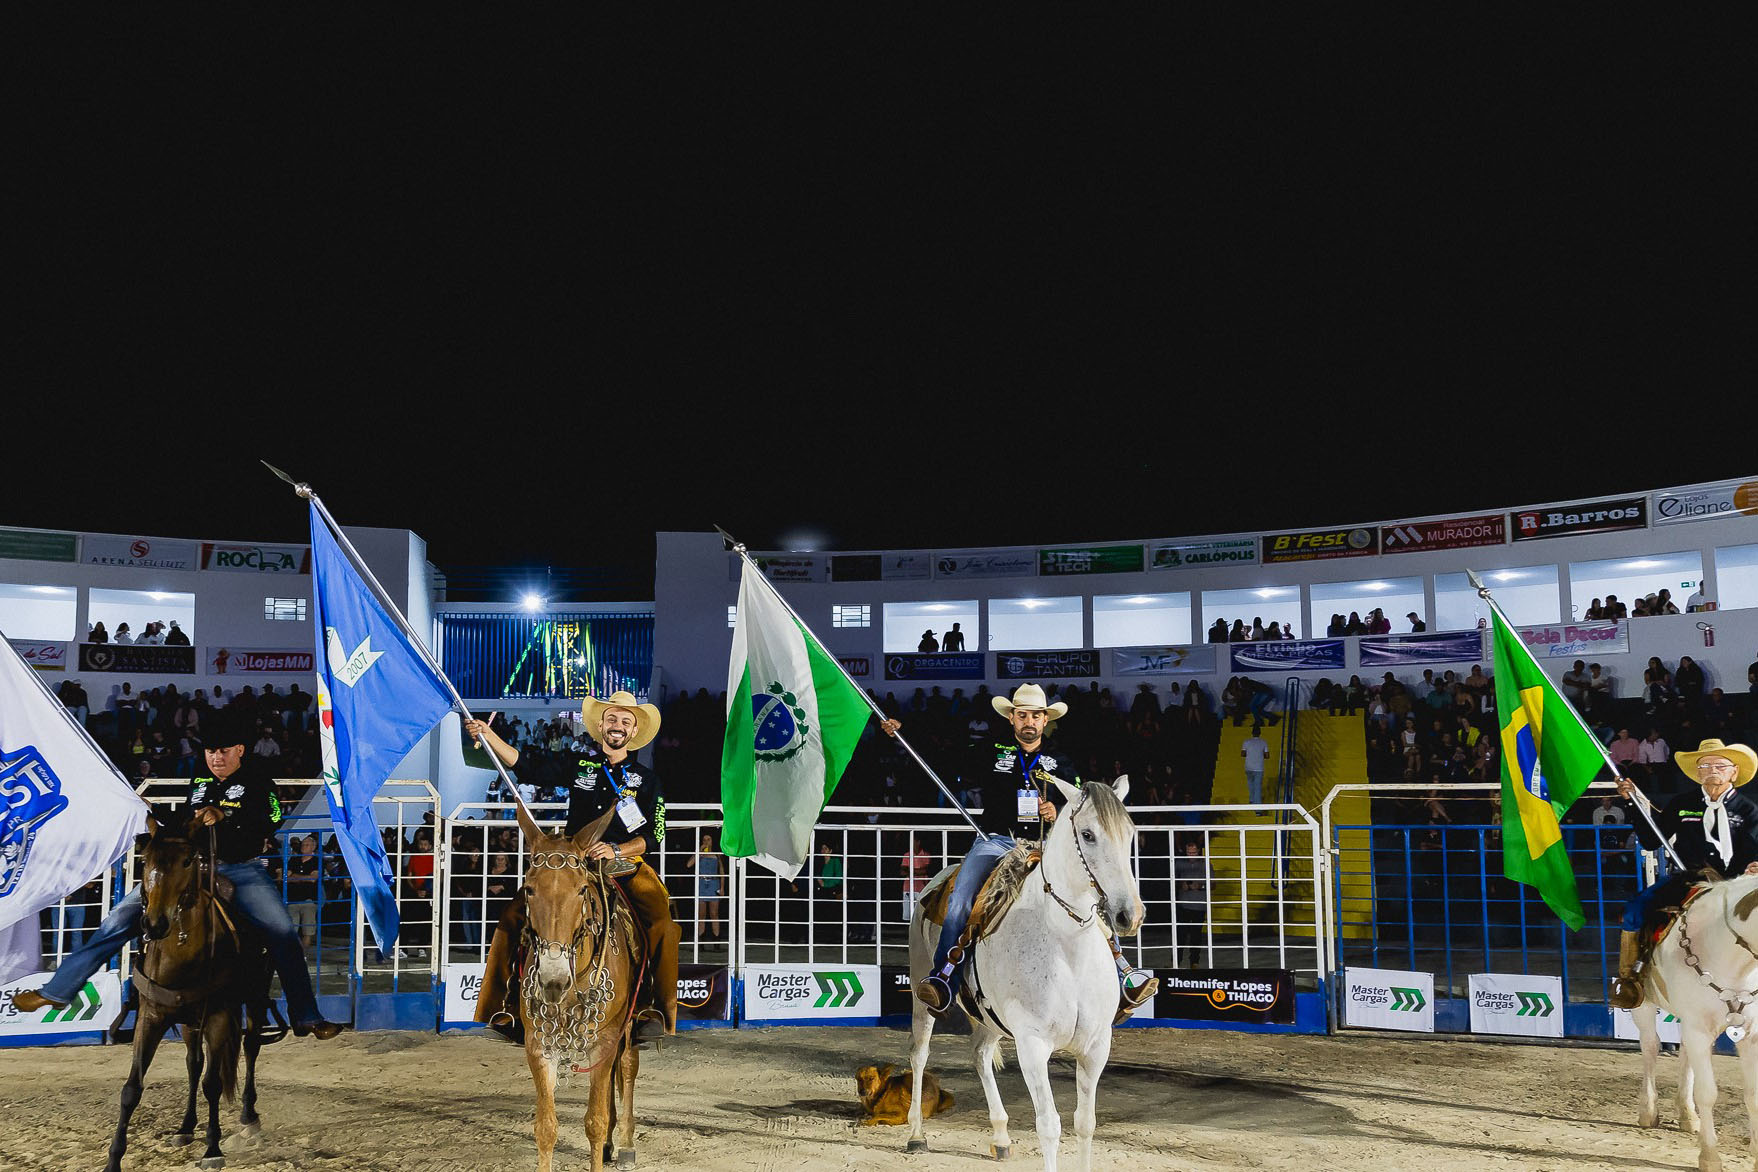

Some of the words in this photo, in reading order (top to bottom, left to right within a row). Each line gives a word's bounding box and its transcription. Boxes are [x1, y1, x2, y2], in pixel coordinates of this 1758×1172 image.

[1427, 525, 1492, 542] MURADOR
[1495, 524, 1503, 536] II
[91, 556, 135, 567] ARENA
[1185, 549, 1255, 563] CARLÓPOLIS
[1056, 562, 1091, 573] TECH
[1549, 643, 1587, 656] Festas
[250, 655, 311, 670] LojasMM
[1036, 652, 1092, 664] GRUPO
[346, 651, 368, 681] 2007
[1033, 664, 1095, 676] TANTINI
[677, 980, 707, 989] opes
[757, 973, 811, 987] Master
[1167, 978, 1231, 990] Jhennifer
[1233, 980, 1272, 992] Lopes
[758, 986, 811, 1001] Cargas
[1351, 984, 1389, 996] Master
[1475, 990, 1515, 1001] Master
[1226, 991, 1275, 1003] THIAGO
[1352, 993, 1388, 1004] Cargas
[1476, 999, 1514, 1010] Cargas
